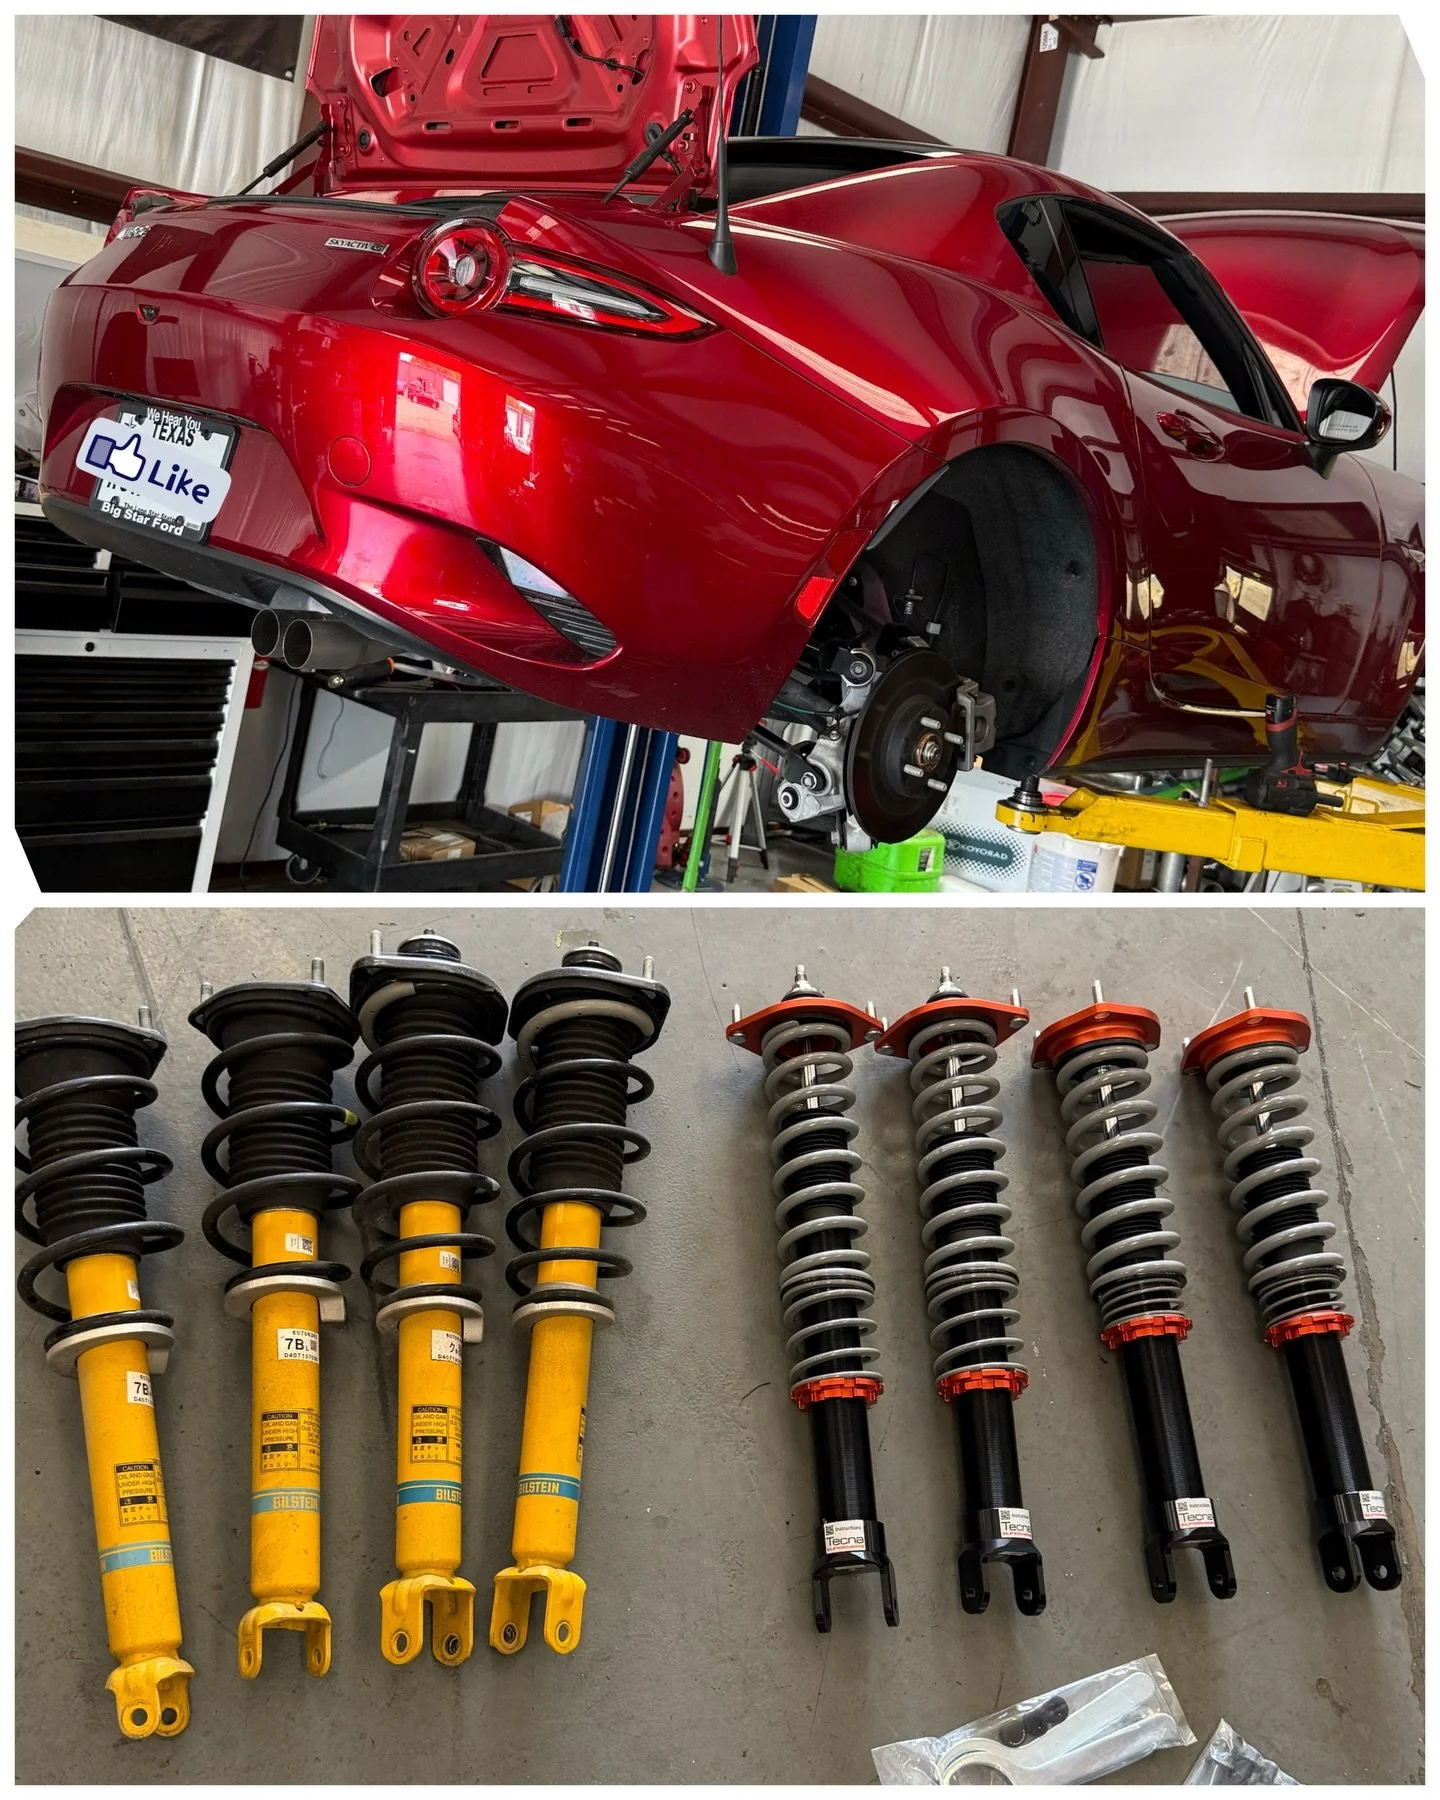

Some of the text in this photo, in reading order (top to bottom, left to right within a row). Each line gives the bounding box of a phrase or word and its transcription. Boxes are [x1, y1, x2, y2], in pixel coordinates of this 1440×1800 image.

[328, 238, 368, 250] SKYACTIV
[147, 407, 202, 431] We Hear You
[152, 419, 196, 447] TEXAS
[101, 501, 122, 519] Big
[124, 508, 151, 525] Star
[151, 517, 185, 537] Ford
[959, 843, 1009, 861] KOYORAD
[284, 1337, 305, 1351] 7B
[133, 1380, 149, 1396] 7B
[122, 1464, 150, 1472] CAUTION
[119, 1480, 141, 1488] UNDER
[122, 1488, 153, 1496] PRESSURE
[826, 1536, 865, 1547] Tecna
